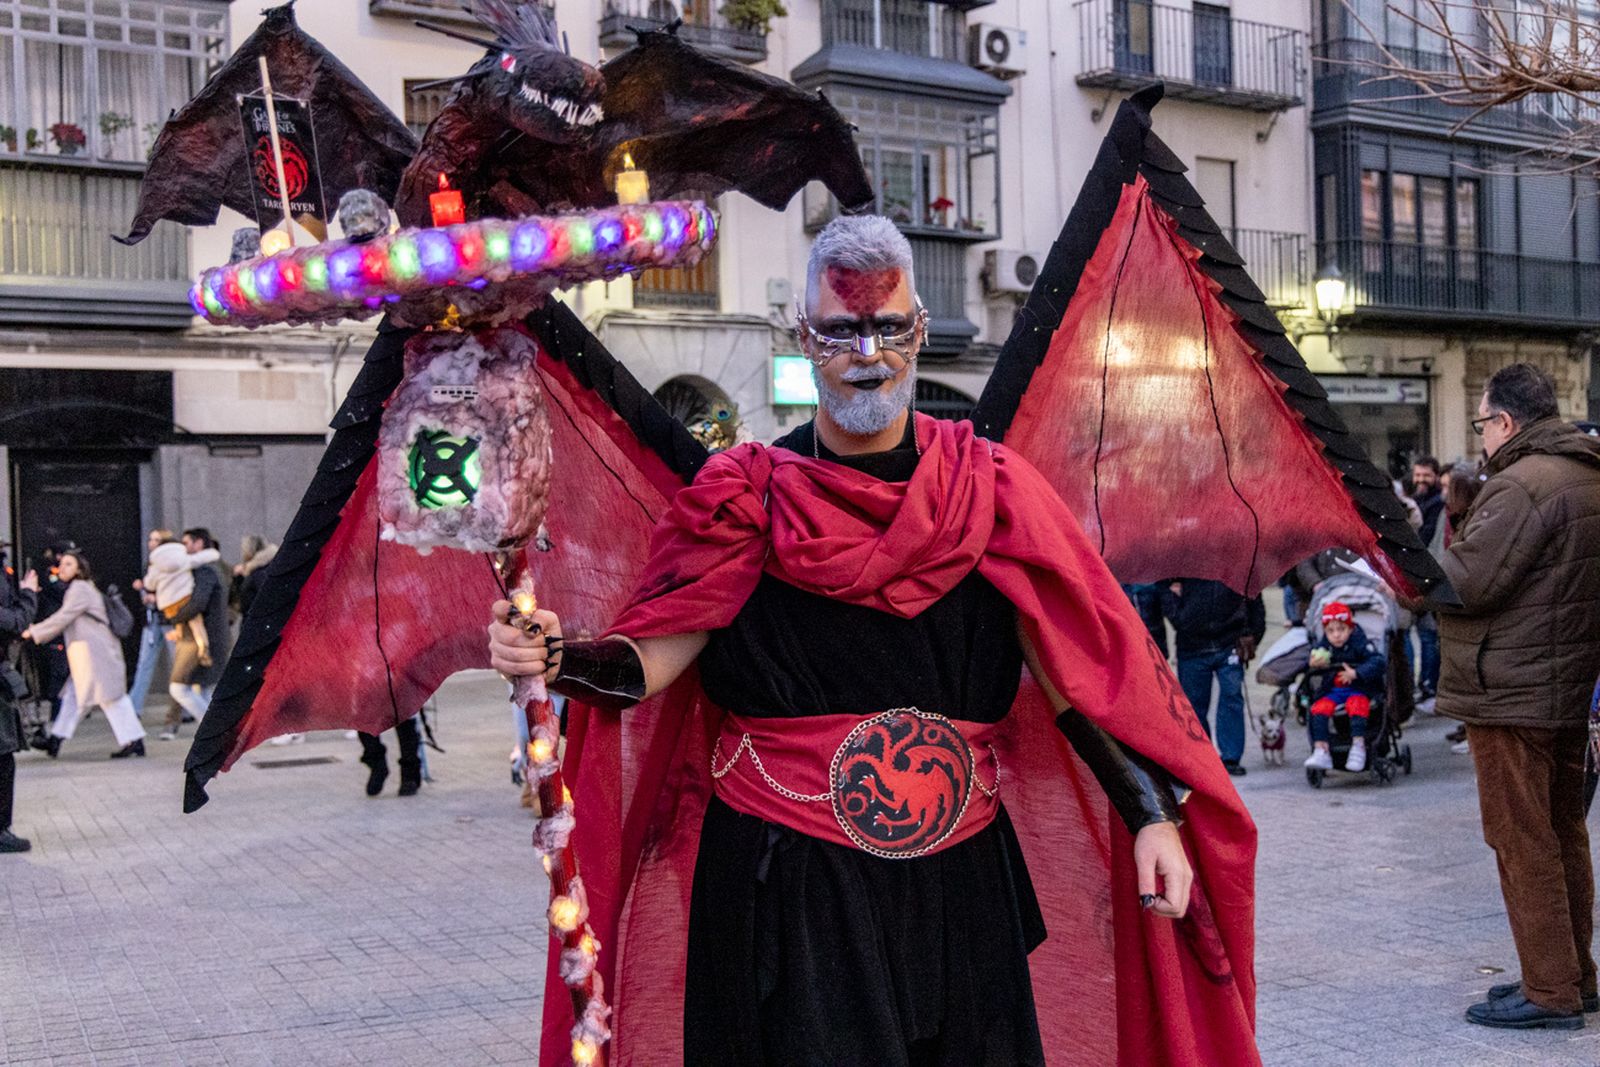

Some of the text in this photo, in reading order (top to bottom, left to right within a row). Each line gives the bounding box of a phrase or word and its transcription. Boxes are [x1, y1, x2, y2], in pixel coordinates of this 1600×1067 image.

[253, 107, 281, 121] GAE
[252, 119, 297, 133] THRNES
[262, 198, 315, 212] TARGRYEN
